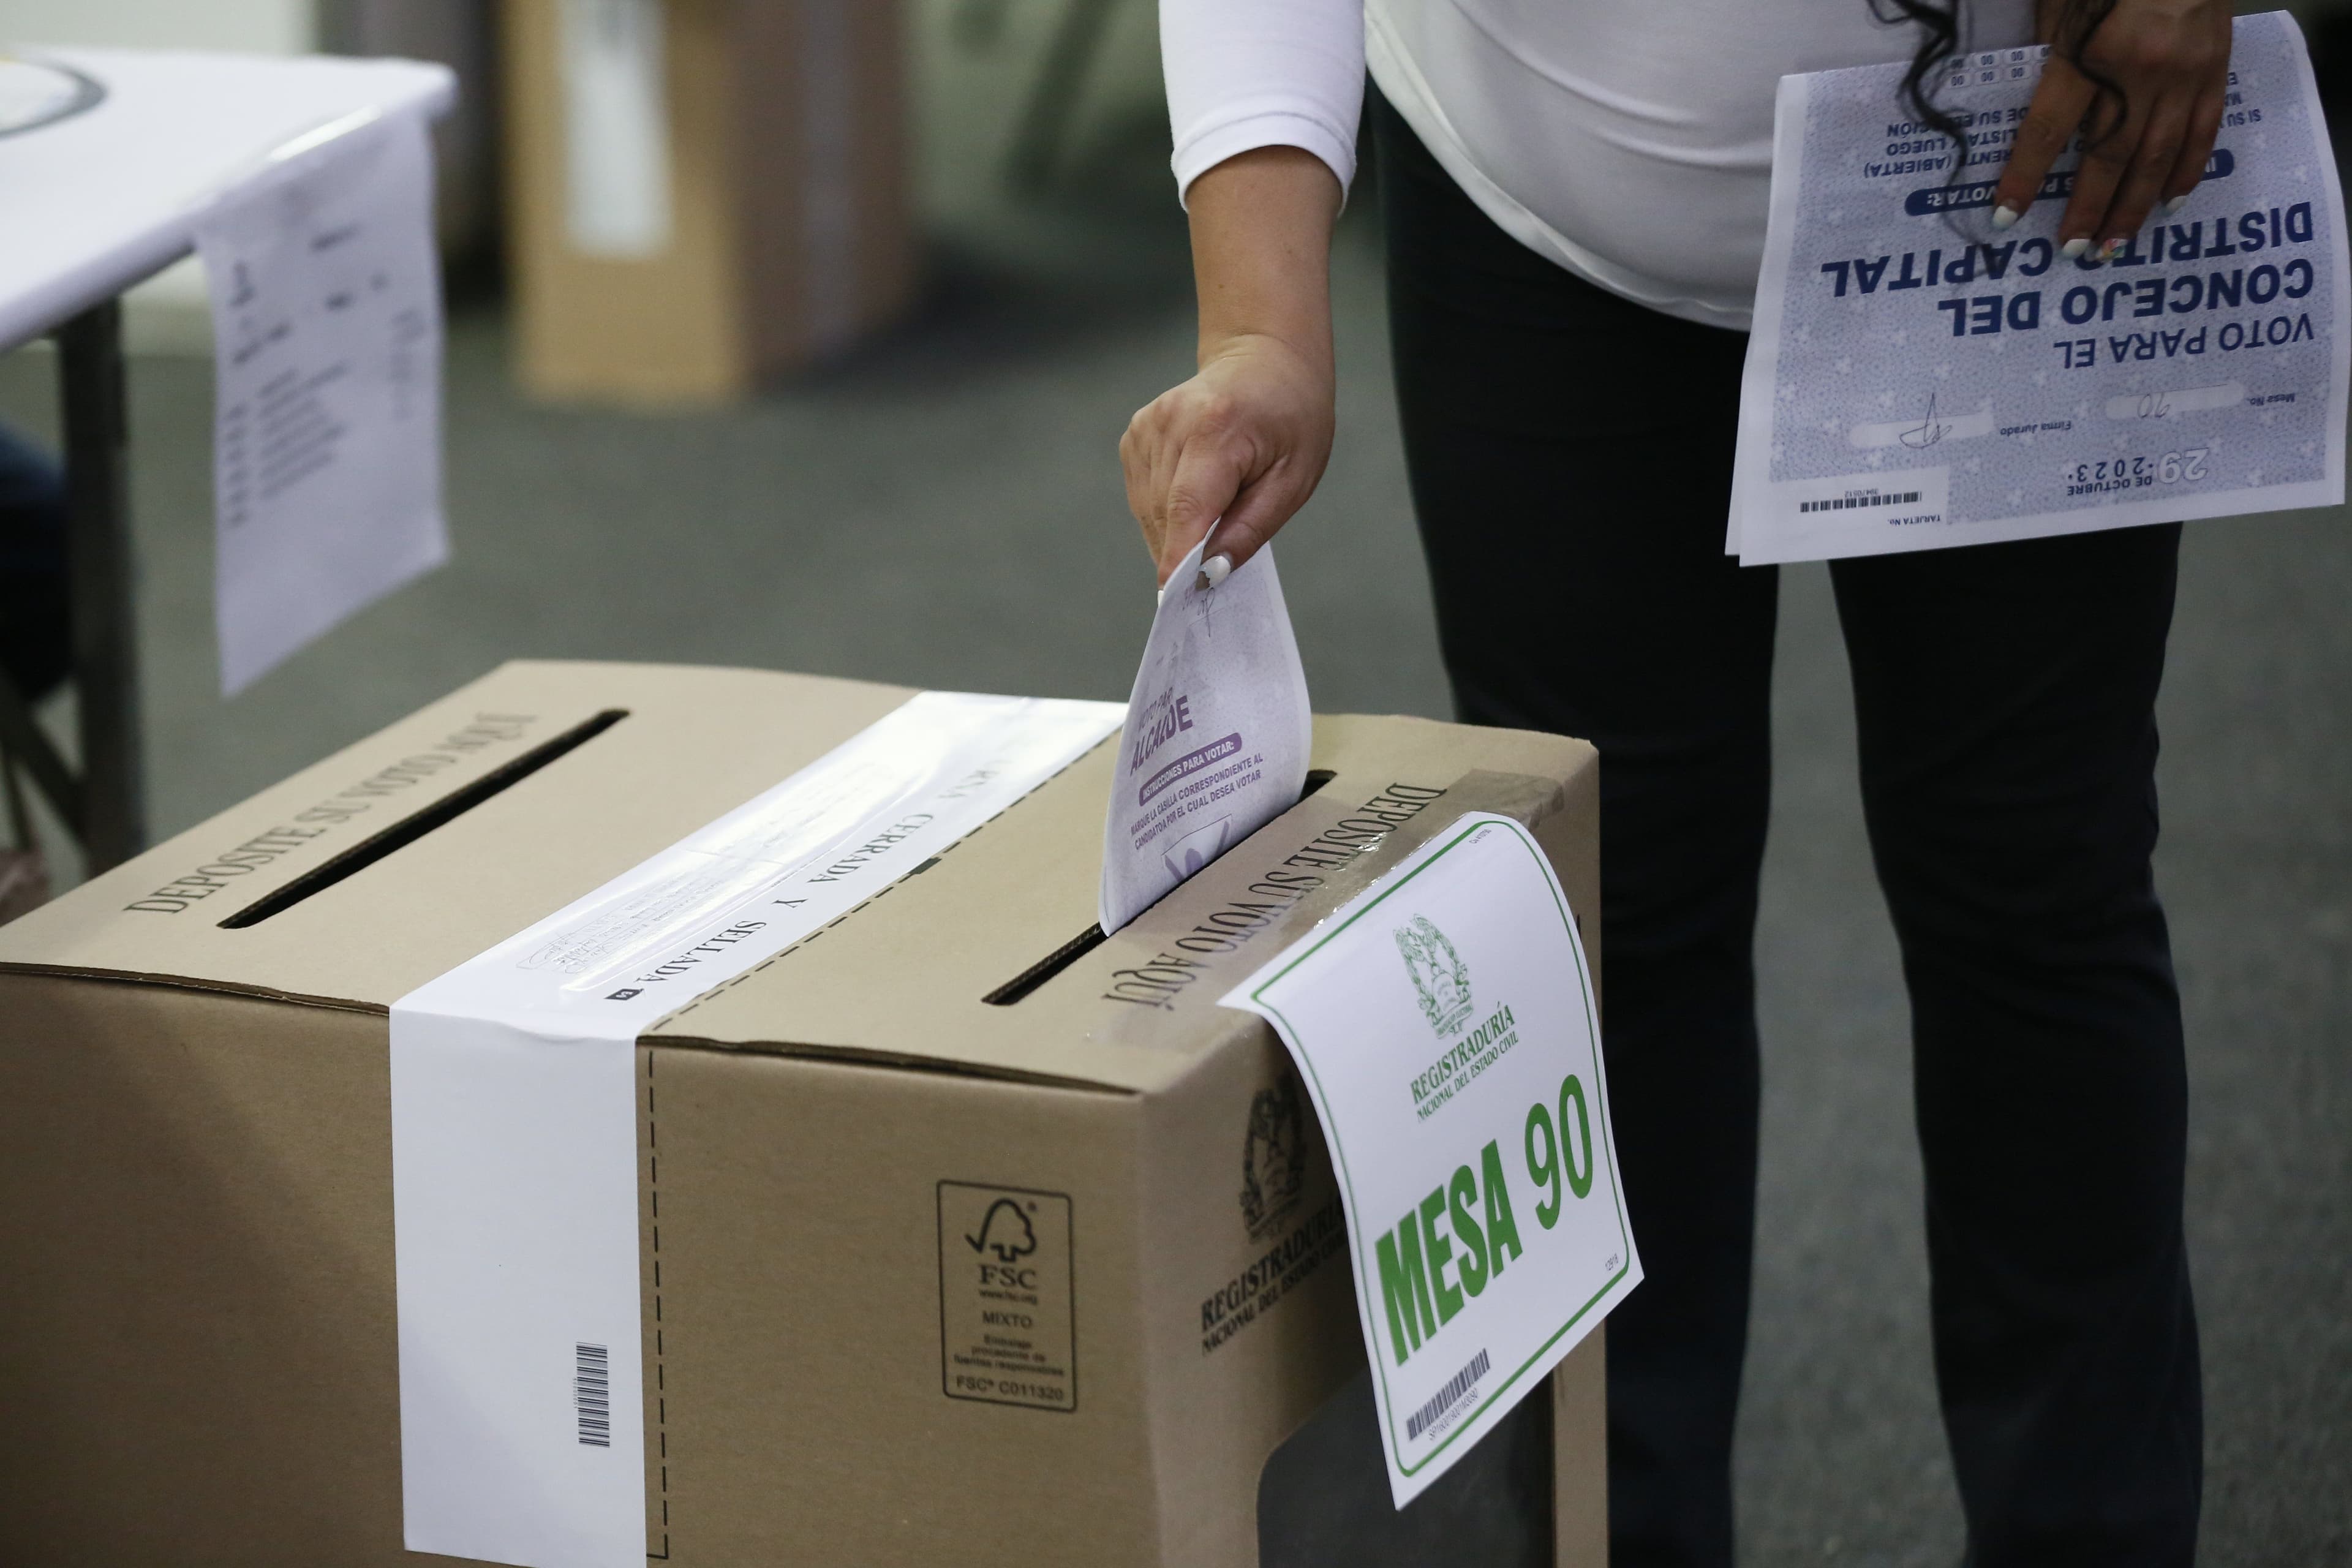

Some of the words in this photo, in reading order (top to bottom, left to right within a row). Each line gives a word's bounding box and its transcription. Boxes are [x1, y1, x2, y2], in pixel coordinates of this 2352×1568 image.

[1978, 111, 2001, 126] SU
[2227, 112, 2245, 127] SU
[1887, 138, 1946, 156] LUEGO
[1821, 236, 2054, 298] CAPITAL
[2061, 257, 2313, 325] CONCEJO
[1939, 297, 2041, 337] DEL
[2217, 312, 2313, 350] VOTO
[2054, 337, 2097, 369] EL
[2109, 325, 2206, 363] PARA
[2267, 393, 2296, 404] Mesa
[2000, 423, 2038, 437] Jurado
[2041, 420, 2072, 431] Firma
[2136, 475, 2153, 487] DE
[2158, 447, 2209, 484] 29
[2067, 478, 2131, 496] OCTUBRE
[1903, 514, 1940, 524] TARJETA
[1130, 695, 1193, 777] ALCALDE
[1142, 764, 1182, 800] INSTRUCCIONES
[1183, 754, 1205, 772] PARA
[1205, 741, 1235, 761] VOTAR:
[1157, 793, 1178, 815] CASILLA
[1178, 757, 1252, 801] CORRESPONDIENTE
[1253, 752, 1264, 765] AL
[1177, 805, 1186, 819] EL
[1186, 795, 1209, 813] CUAL
[1210, 784, 1235, 802] DESEA
[1236, 769, 1262, 790] VOTAR
[1283, 783, 1447, 872] DEPOSITE
[808, 813, 934, 883] CERRADA
[121, 826, 327, 914] DEPOSITE
[1248, 871, 1324, 904] SU
[771, 897, 809, 909] Y
[1176, 902, 1294, 953] VOTO
[633, 920, 767, 983] SELLADA
[1410, 1000, 1515, 1104] REGISTRADURÍA
[1417, 1085, 1454, 1124] NACIONAL
[1454, 1071, 1470, 1092] DEL
[1470, 1046, 1498, 1079] ESTADO
[1498, 1030, 1519, 1055] CIVIL
[1374, 1138, 1523, 1368] MESA
[1524, 1073, 1593, 1231] 90
[978, 1264, 1037, 1290] FSC
[982, 1311, 1033, 1329] MIXTO
